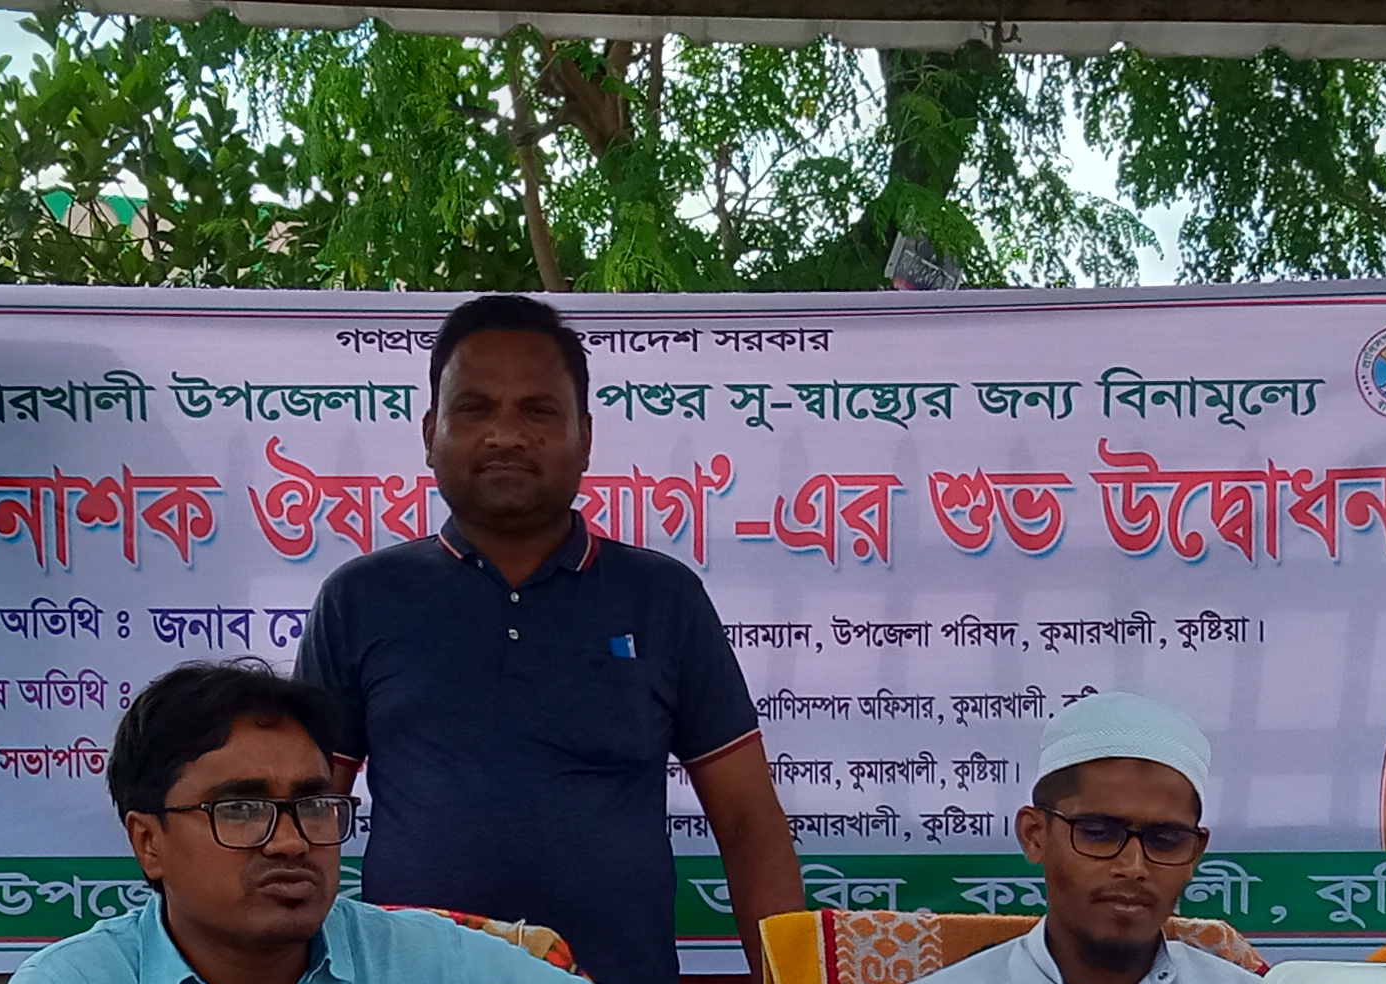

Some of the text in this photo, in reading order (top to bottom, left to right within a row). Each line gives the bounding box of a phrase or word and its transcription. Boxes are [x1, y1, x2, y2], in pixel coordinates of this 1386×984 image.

[575, 328, 703, 355] ংলাদেশ
[711, 328, 833, 352] সরকার
[167, 371, 420, 423] উপজেলায়
[595, 380, 713, 421] পশুর
[971, 381, 1082, 421] জন্য
[1094, 366, 1326, 430] বিনামূল্যে
[928, 466, 1073, 552] শুভ
[0, 597, 103, 640] অতিথি
[148, 605, 254, 649] জনাব
[831, 615, 932, 647] উপজেলা
[1037, 611, 1167, 653] কুমারখালী,
[17, 668, 109, 710] অতিথি
[756, 688, 853, 721] প্রাণিসম্পদ
[857, 688, 944, 725] অফিসার,
[846, 751, 947, 792] কুমারখালী,
